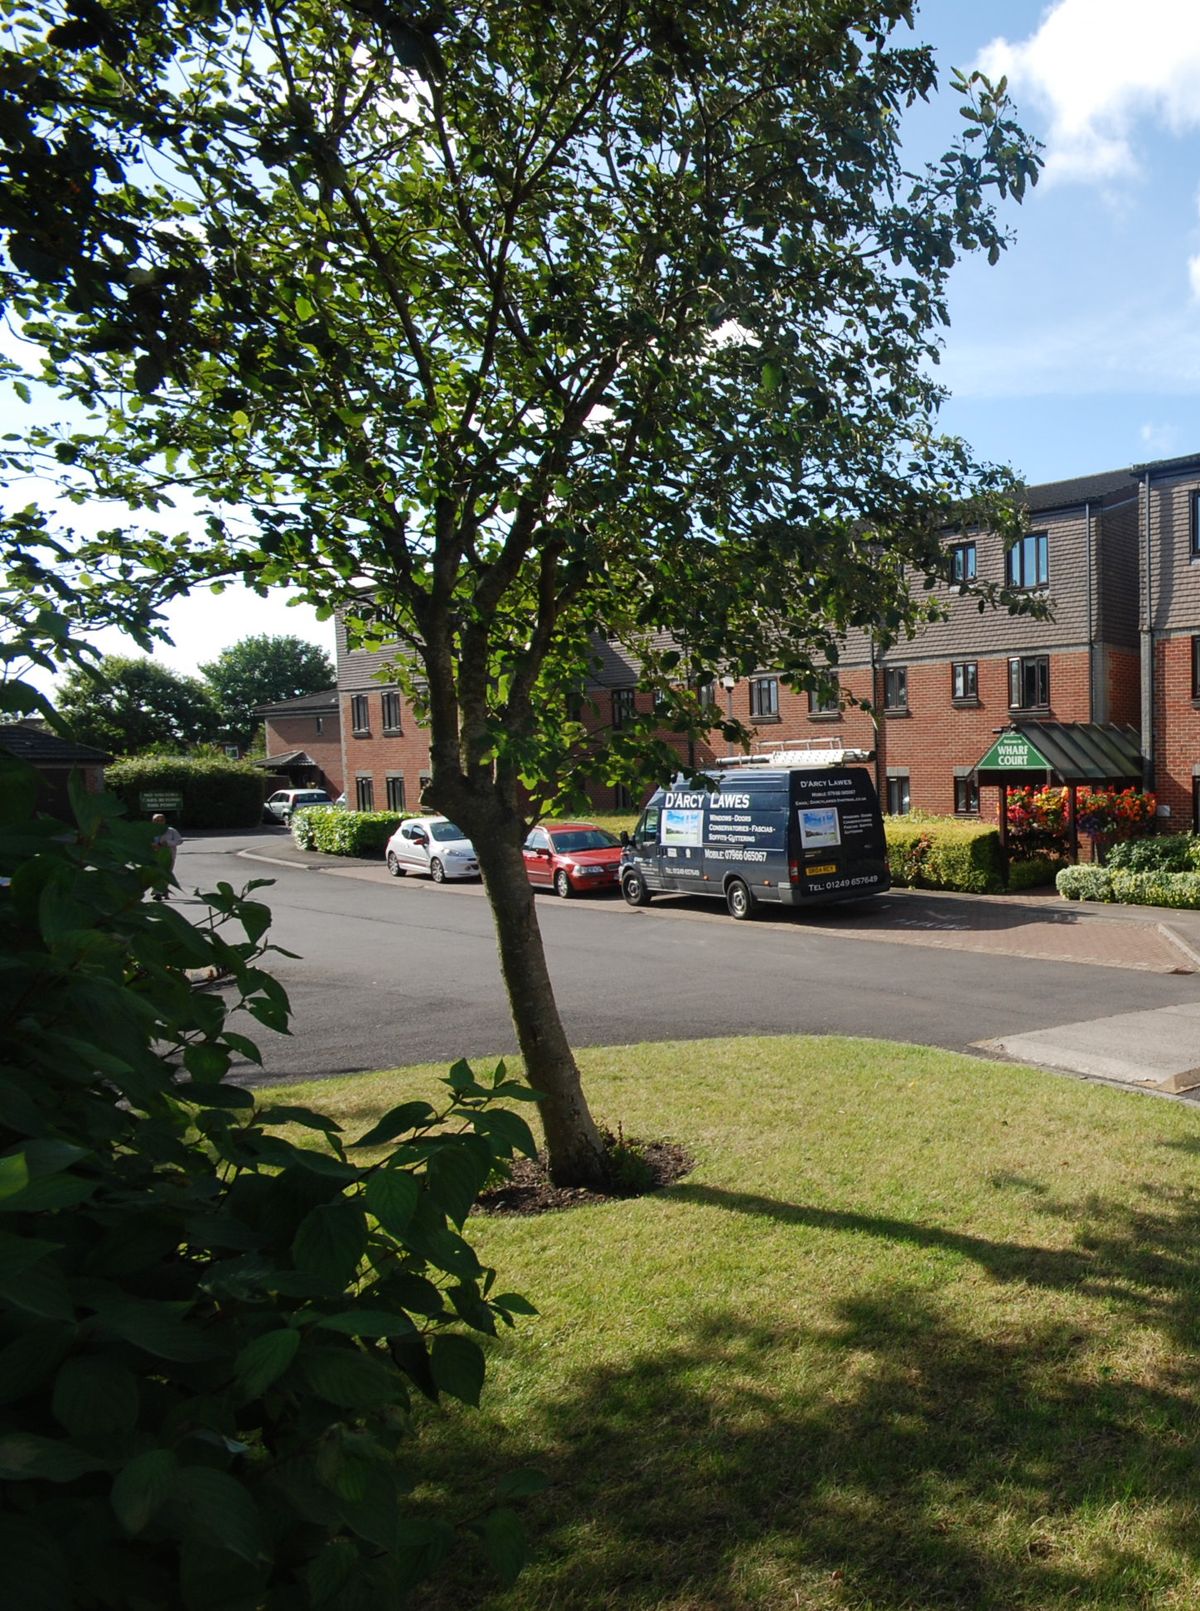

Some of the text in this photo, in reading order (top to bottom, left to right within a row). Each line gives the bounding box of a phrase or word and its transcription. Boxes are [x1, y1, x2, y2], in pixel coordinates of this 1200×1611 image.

[997, 745, 1028, 755] WHARF
[998, 755, 1028, 765] COURT
[828, 779, 853, 787] LAWES
[665, 792, 750, 809] D'ARCY LAWES
[725, 850, 743, 860] 07966
[826, 879, 850, 889] 01249
